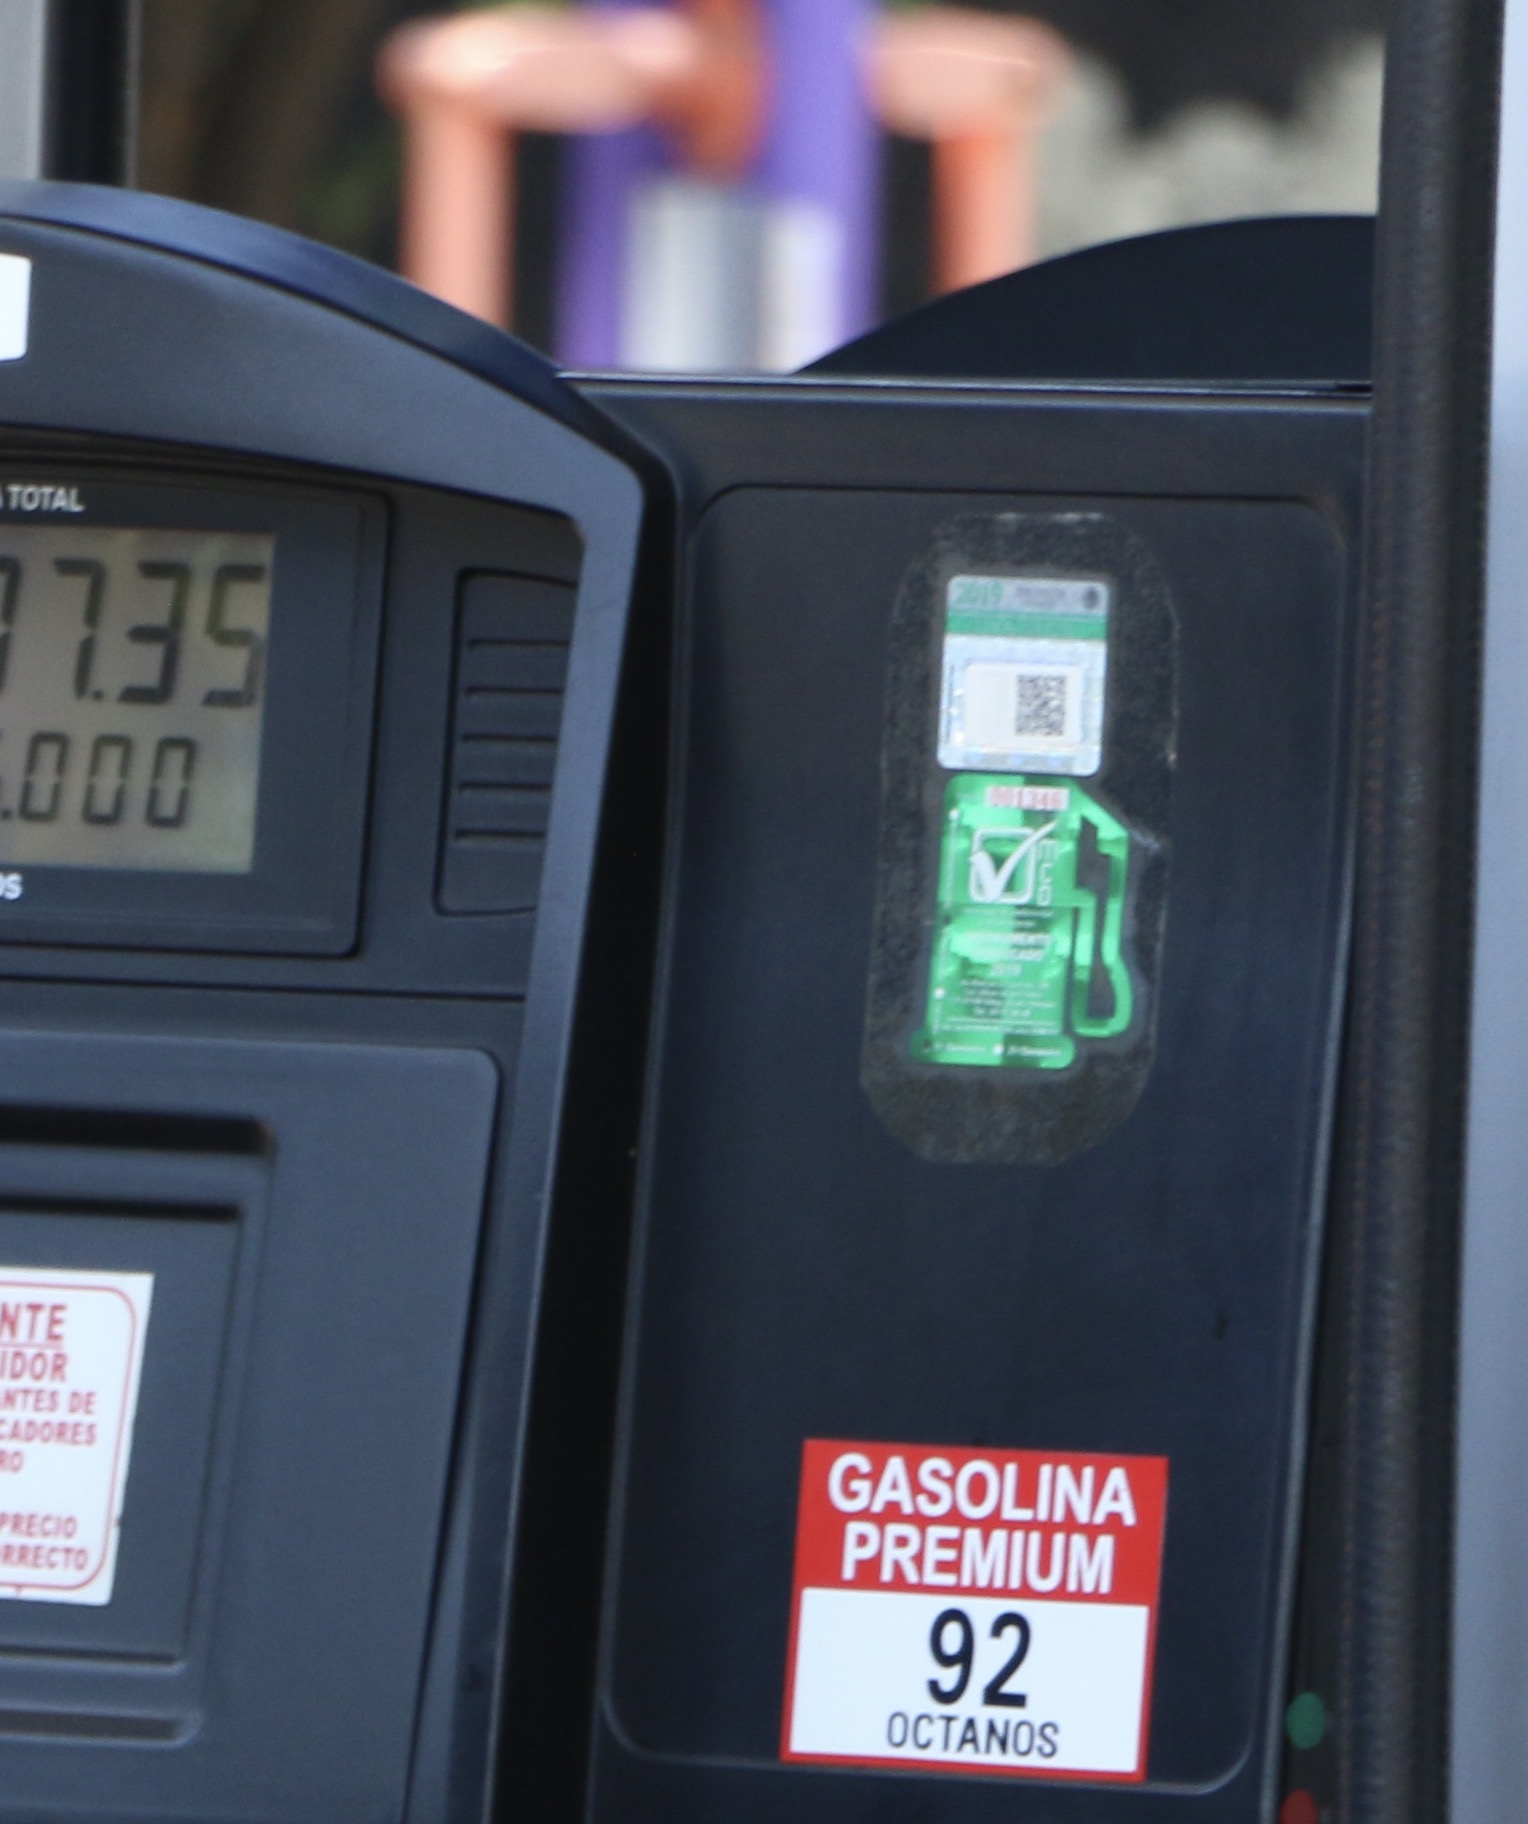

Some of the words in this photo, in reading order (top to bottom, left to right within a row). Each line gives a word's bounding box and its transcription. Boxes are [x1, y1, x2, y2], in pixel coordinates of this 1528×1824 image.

[8, 485, 85, 512] TOTAL
[68, 1391, 97, 1415] DE
[827, 1452, 1138, 1527] GASOLINA
[841, 1520, 1115, 1595] PREMIUM
[925, 1607, 1033, 1710] 92
[886, 1711, 1061, 1759] OCTANOS
